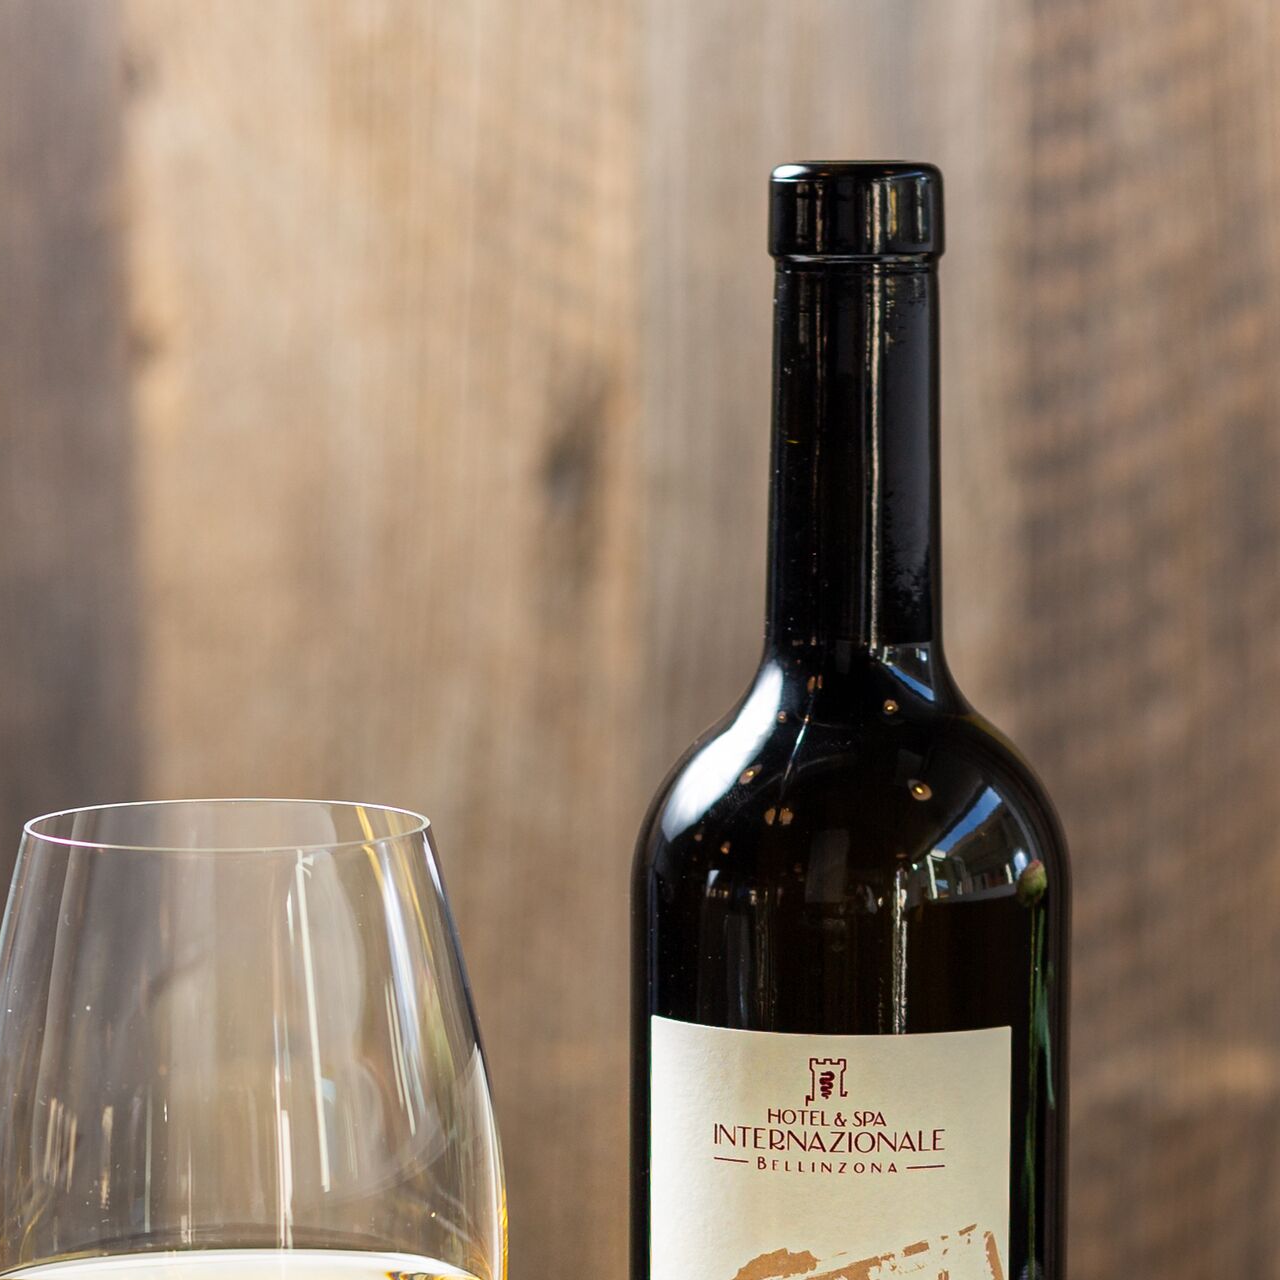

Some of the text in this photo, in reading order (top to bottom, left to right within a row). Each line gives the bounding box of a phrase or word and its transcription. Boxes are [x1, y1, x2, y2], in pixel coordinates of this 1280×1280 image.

[767, 1108, 887, 1127] HOTEL & SPA
[713, 1123, 945, 1153] INTERNAZIONALE
[757, 1156, 898, 1174] BELLINZONA
